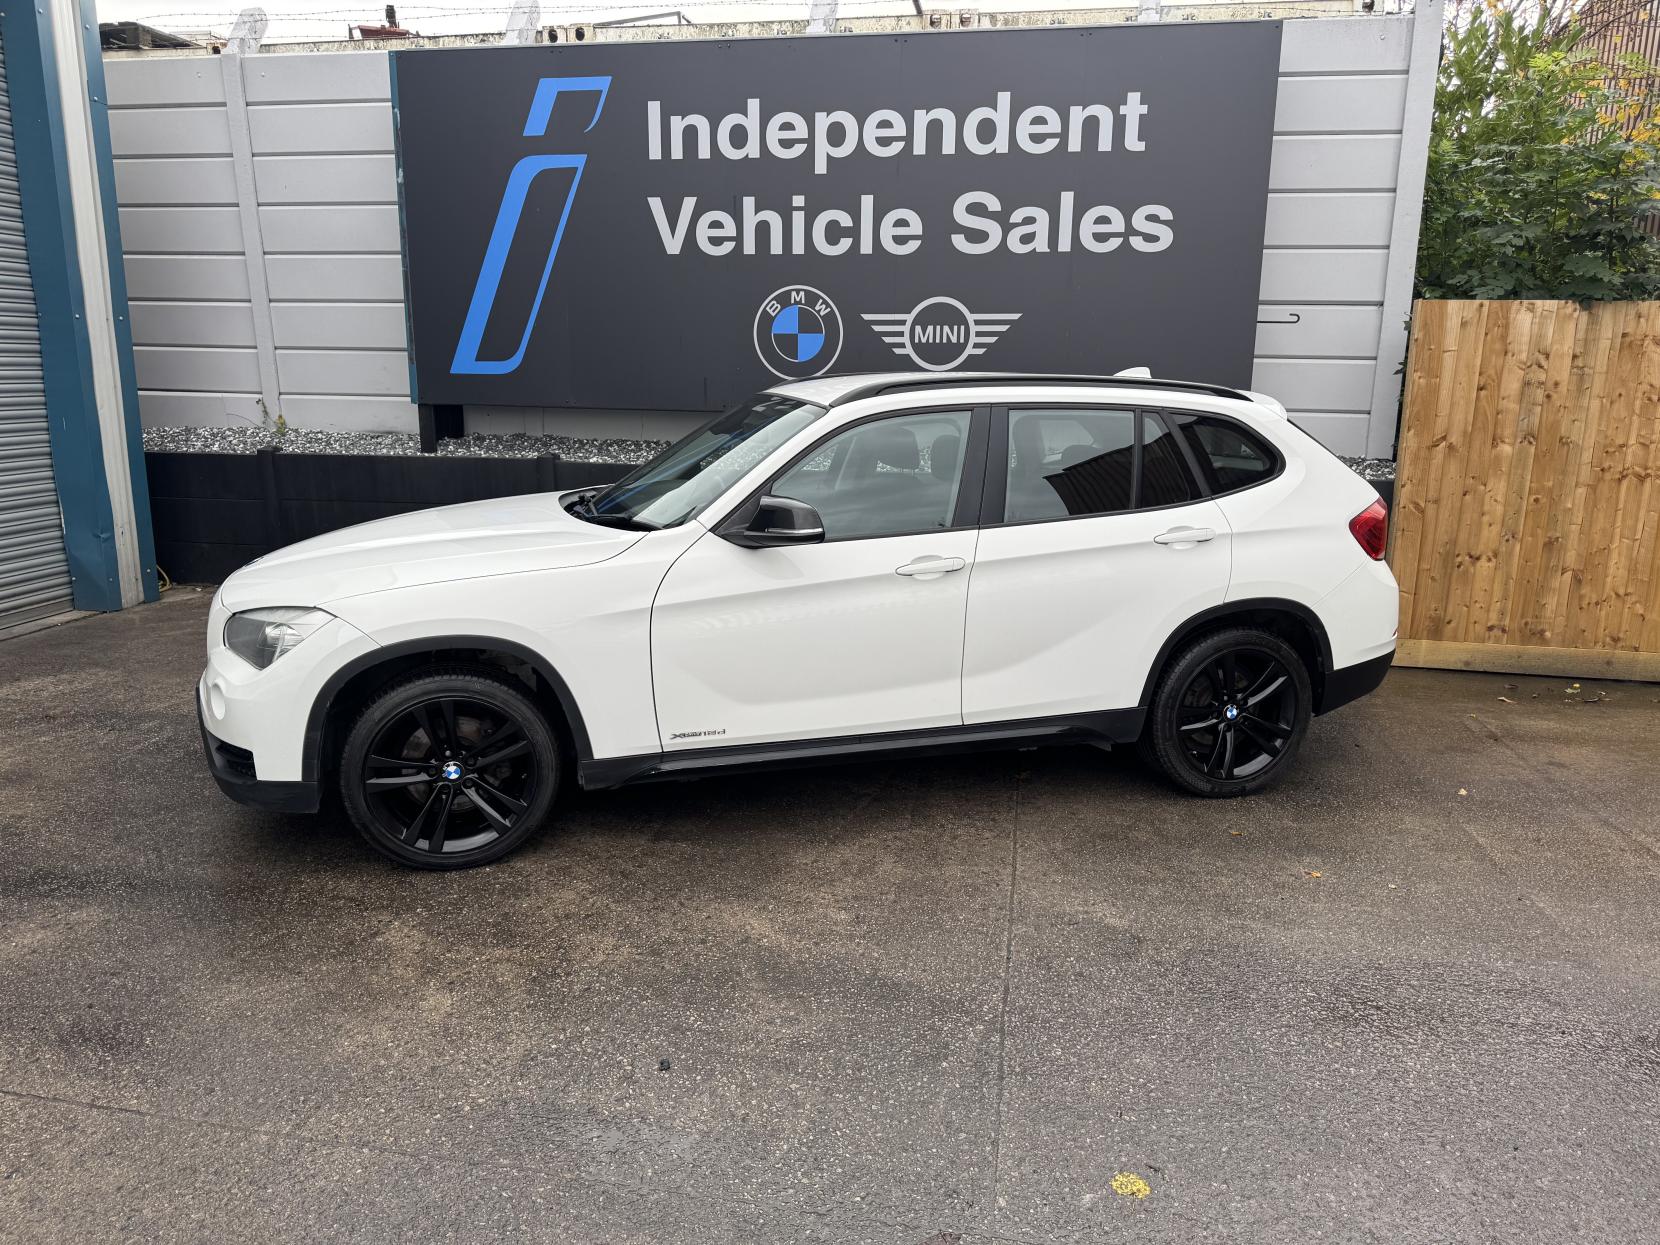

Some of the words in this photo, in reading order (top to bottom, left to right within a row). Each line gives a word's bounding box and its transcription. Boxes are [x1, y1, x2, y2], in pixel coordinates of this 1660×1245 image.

[647, 91, 1148, 174] Independent
[647, 195, 923, 256] Vehicle
[951, 191, 1174, 255] Sales
[765, 290, 831, 318] BMW
[914, 325, 965, 344] MINI
